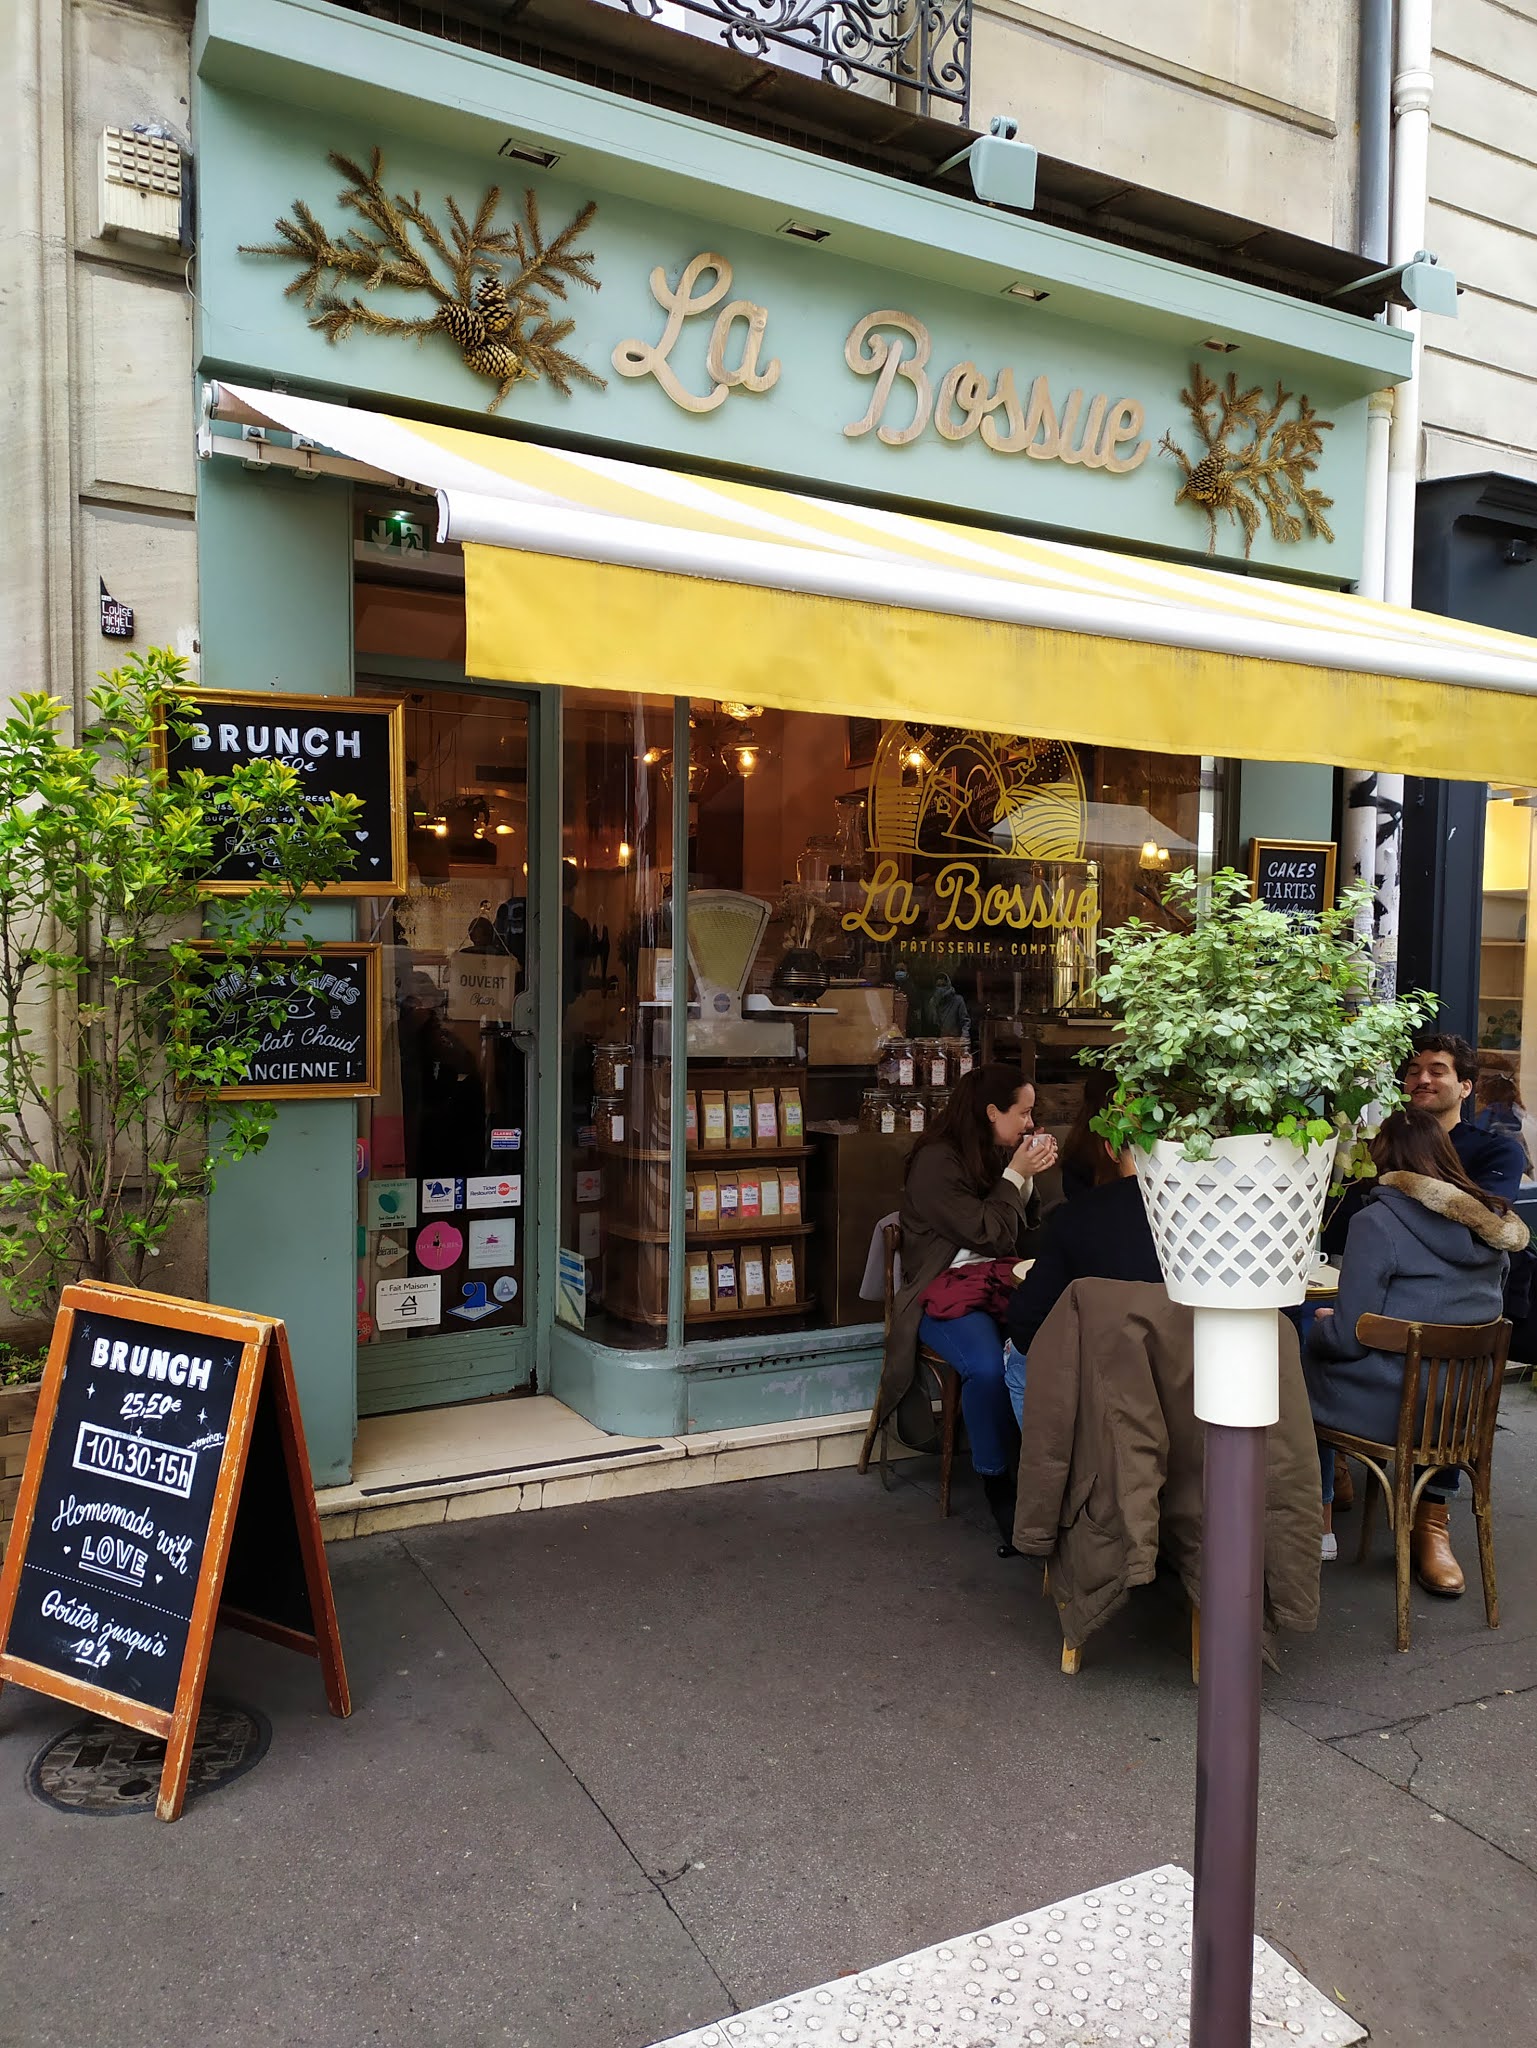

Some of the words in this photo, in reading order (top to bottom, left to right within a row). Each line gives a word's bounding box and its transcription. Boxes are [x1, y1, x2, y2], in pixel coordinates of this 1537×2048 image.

[611, 252, 781, 412] La
[842, 309, 1151, 473] Bossue
[191, 722, 361, 759] BRUNCH
[1267, 861, 1317, 879] CAKES
[841, 859, 920, 942] La
[935, 862, 1101, 931] Bossue
[1263, 881, 1317, 900] TARTES
[900, 936, 991, 954] PÂTISSERIE
[460, 974, 507, 989] OUVERT
[301, 1024, 361, 1054] Chaud
[389, 1284, 402, 1292] Fait
[403, 1282, 429, 1291] Maison
[90, 1337, 213, 1392] BRUNCH
[120, 1392, 182, 1416] 25,50€
[86, 1434, 189, 1489] 10h30-15h
[51, 1494, 154, 1539] Homemade
[156, 1530, 193, 1575] with
[81, 1535, 149, 1578] LOVE
[41, 1589, 99, 1633] Goûter
